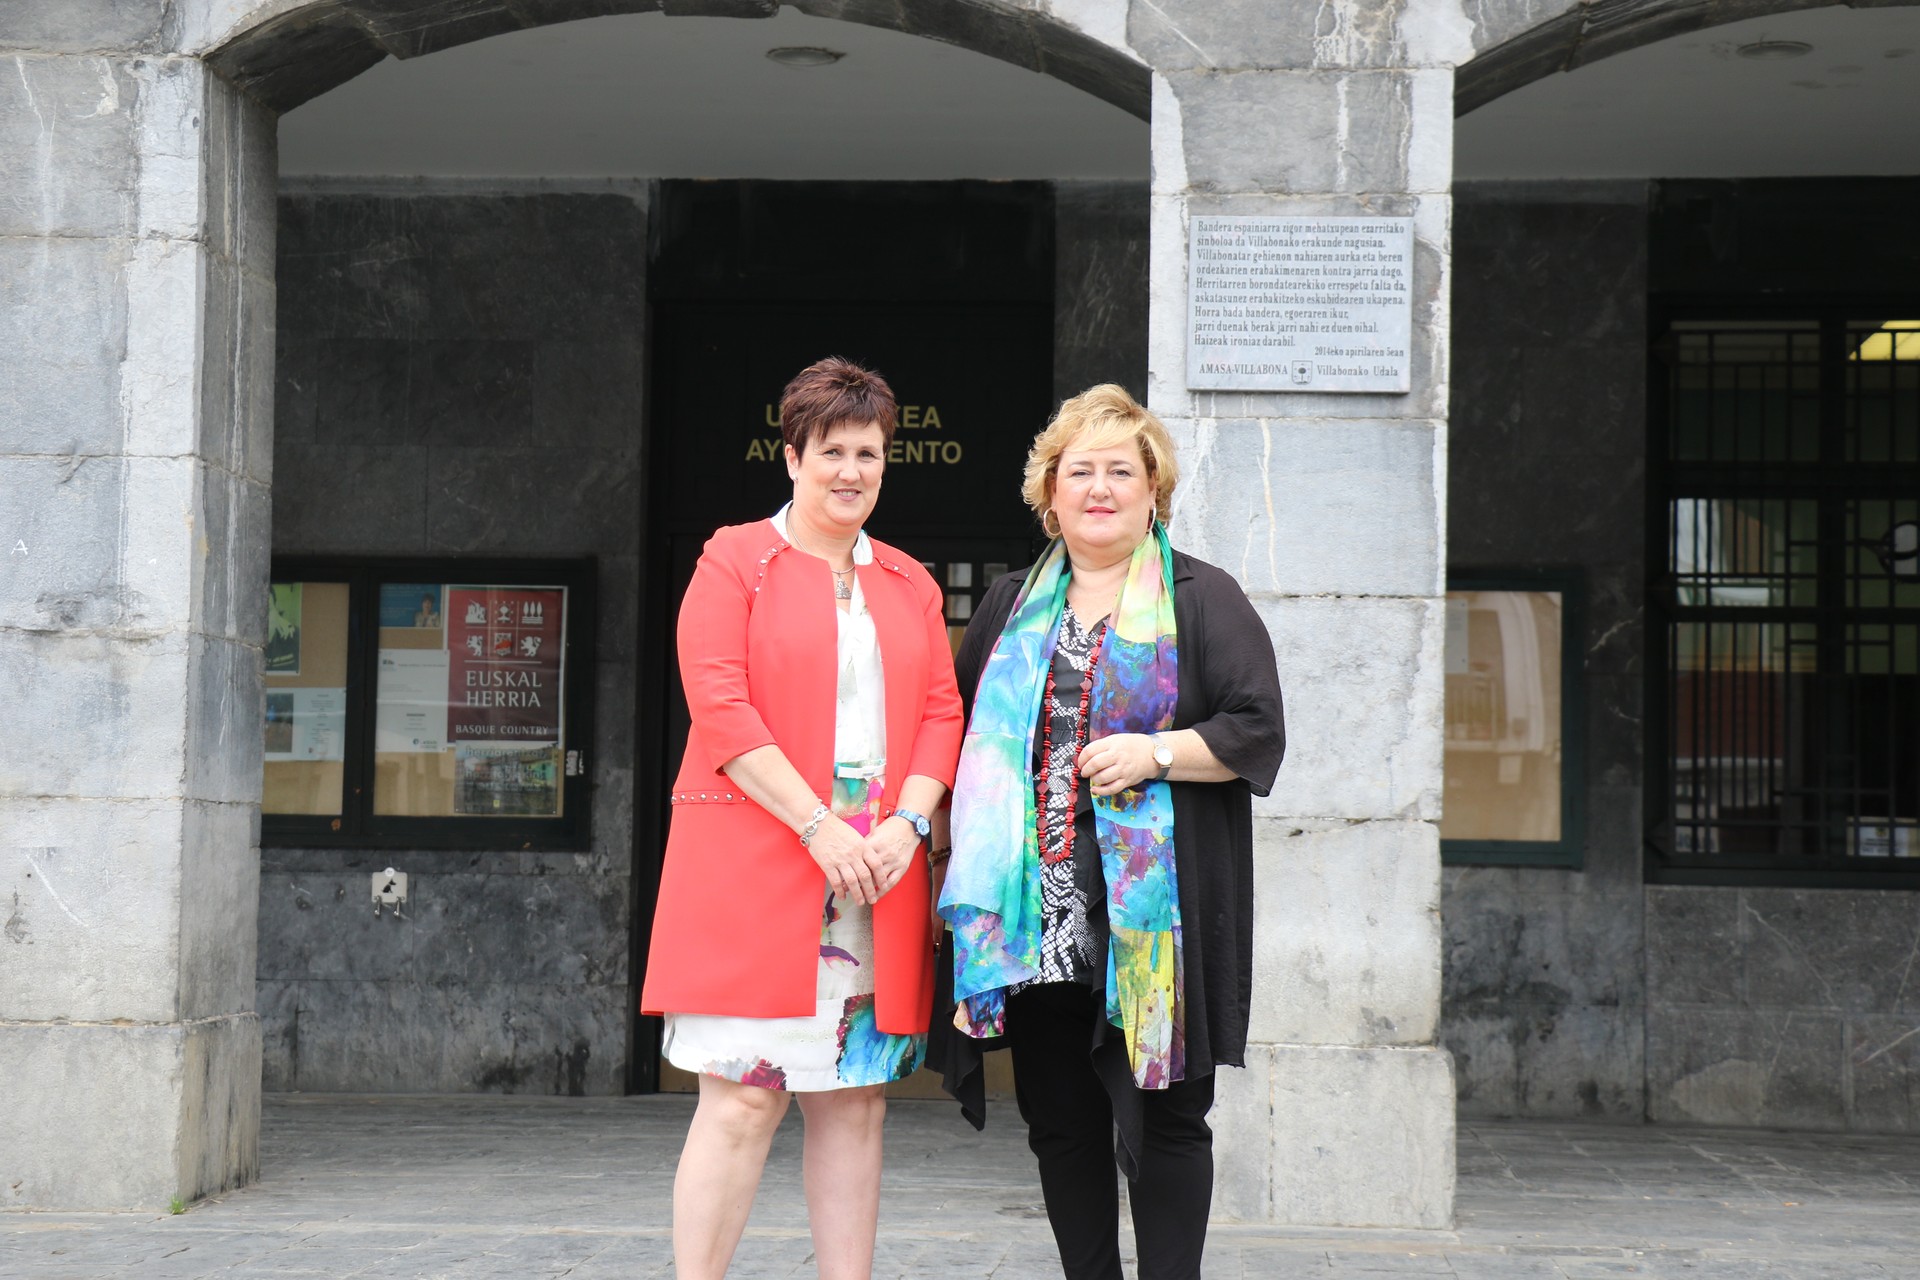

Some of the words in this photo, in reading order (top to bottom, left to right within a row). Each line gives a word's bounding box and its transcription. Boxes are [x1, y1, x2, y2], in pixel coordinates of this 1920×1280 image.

[1198, 221, 1232, 232] Bandera
[1234, 222, 1280, 234] espainiarra
[1282, 223, 1302, 235] zigor
[1305, 222, 1359, 235] mehatxupean
[1362, 222, 1404, 233] ezarritako
[1196, 236, 1232, 246] sinboloa
[1235, 236, 1245, 246] da
[1248, 236, 1299, 247] Villabonako
[1302, 237, 1342, 247] erakunde
[1344, 237, 1386, 250] nagusian.
[1197, 249, 1250, 260] Villabonatar
[1253, 250, 1292, 263] gehienon
[1294, 250, 1333, 261] nahiaren
[1335, 251, 1360, 261] aurka
[1362, 252, 1375, 261] eta
[1378, 251, 1402, 262] beren
[1196, 264, 1247, 275] ordezkarien
[1250, 264, 1320, 276] erabakimenaren
[1322, 265, 1351, 276] kontra
[1353, 265, 1378, 278] jarria
[1380, 266, 1403, 279] dago.
[1196, 277, 1246, 288] Herritarren
[1249, 278, 1325, 290] borondatearekiko
[1328, 280, 1368, 292] errespetu
[1370, 280, 1391, 290] falta
[1394, 280, 1406, 292] da,
[1195, 292, 1247, 303] askatasunez
[1249, 293, 1304, 304] erabakitzeko
[1306, 294, 1364, 304] eskubidearen
[1366, 294, 1405, 307] ukapena.
[1195, 306, 1220, 317] Horra
[1222, 306, 1242, 317] bada
[1245, 306, 1282, 318] bandera,
[1284, 309, 1327, 320] egoeraren
[1194, 320, 1214, 333] jarri
[1216, 320, 1248, 332] duenak
[1251, 321, 1275, 332] berak
[1277, 322, 1296, 334] jarri
[1299, 322, 1318, 332] nahi
[1331, 322, 1352, 332] duen
[1355, 322, 1378, 332] oihal.
[1194, 334, 1228, 345] Haizeak
[1230, 335, 1260, 346] ironiaz
[1262, 335, 1296, 346] darabil.
[1315, 346, 1343, 356] 2014eko
[1345, 346, 1384, 358] apirilaren
[1386, 347, 1404, 357] 5ean
[1199, 364, 1288, 375] AMASA-VILLABONA
[1317, 365, 1368, 376] Villabonako
[1373, 366, 1398, 376] Udala
[466, 670, 542, 687] EUSKAL
[466, 691, 540, 707] HERRIA
[456, 724, 495, 735] BASQUE
[500, 726, 548, 735] COUNTRY
